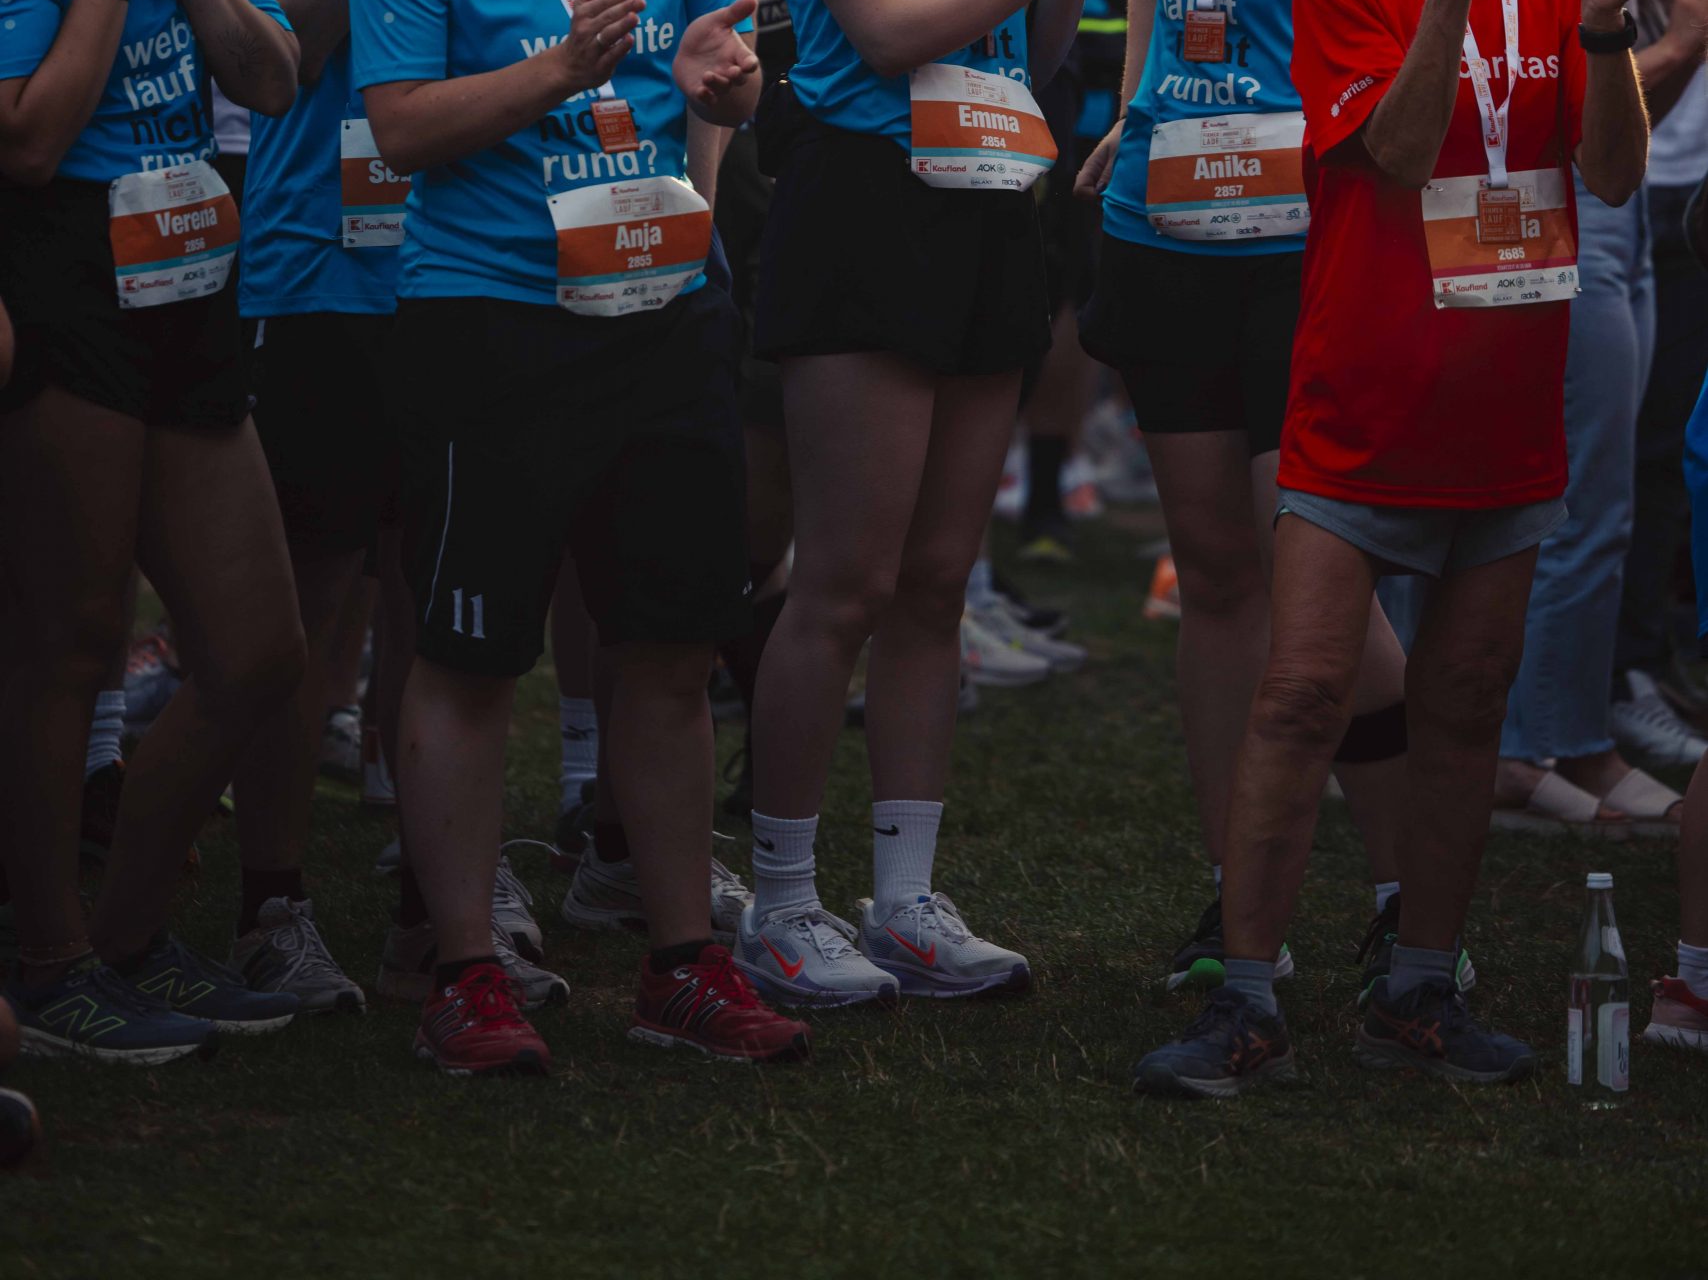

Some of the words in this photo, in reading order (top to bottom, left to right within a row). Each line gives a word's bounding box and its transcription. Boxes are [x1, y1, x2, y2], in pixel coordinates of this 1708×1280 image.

[1156, 72, 1262, 105] rund?
[1338, 75, 1375, 106] caritas
[958, 105, 1020, 134] Emma
[981, 135, 1007, 149] 2854
[932, 164, 967, 173] Kaufland
[976, 163, 996, 172] AOK
[1193, 154, 1262, 180] Anika
[1214, 185, 1244, 198] 2857
[154, 206, 218, 237] Verena
[1210, 214, 1231, 224] AOK
[614, 222, 663, 251] Anja
[1497, 247, 1525, 261] 2685
[627, 254, 653, 269] 2855
[1456, 283, 1488, 293] Kaufland
[1497, 278, 1516, 288] AOK
[452, 587, 486, 639] 11
